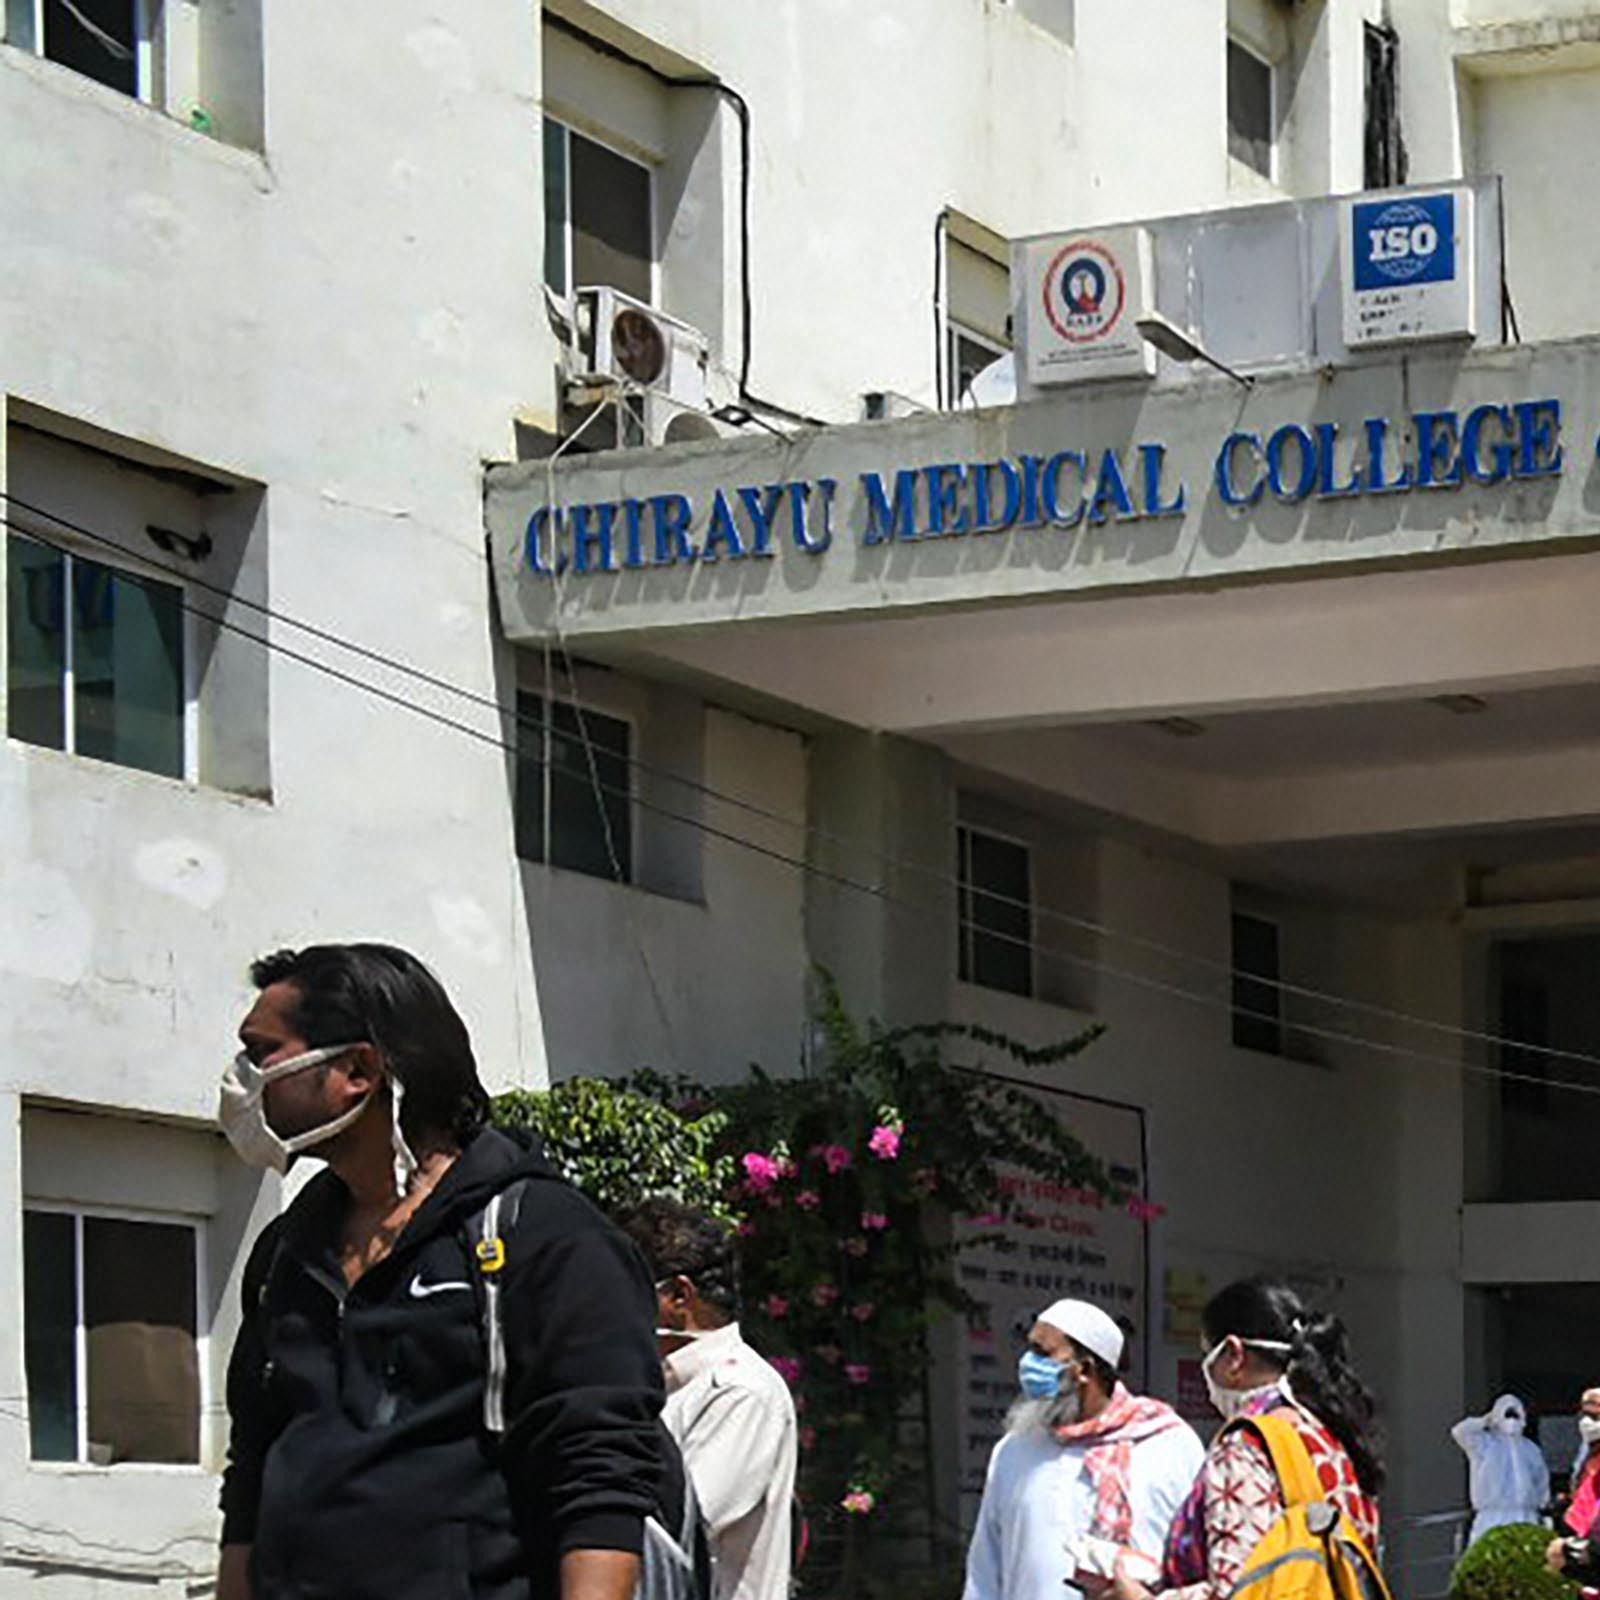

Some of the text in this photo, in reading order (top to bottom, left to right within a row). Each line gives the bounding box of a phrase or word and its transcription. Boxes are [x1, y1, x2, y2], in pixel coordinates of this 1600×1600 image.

[1369, 223, 1438, 262] ISO
[524, 477, 836, 578] CHIRAYU
[861, 443, 1186, 547] MEDICAL
[1215, 400, 1562, 507] COLLEGE
